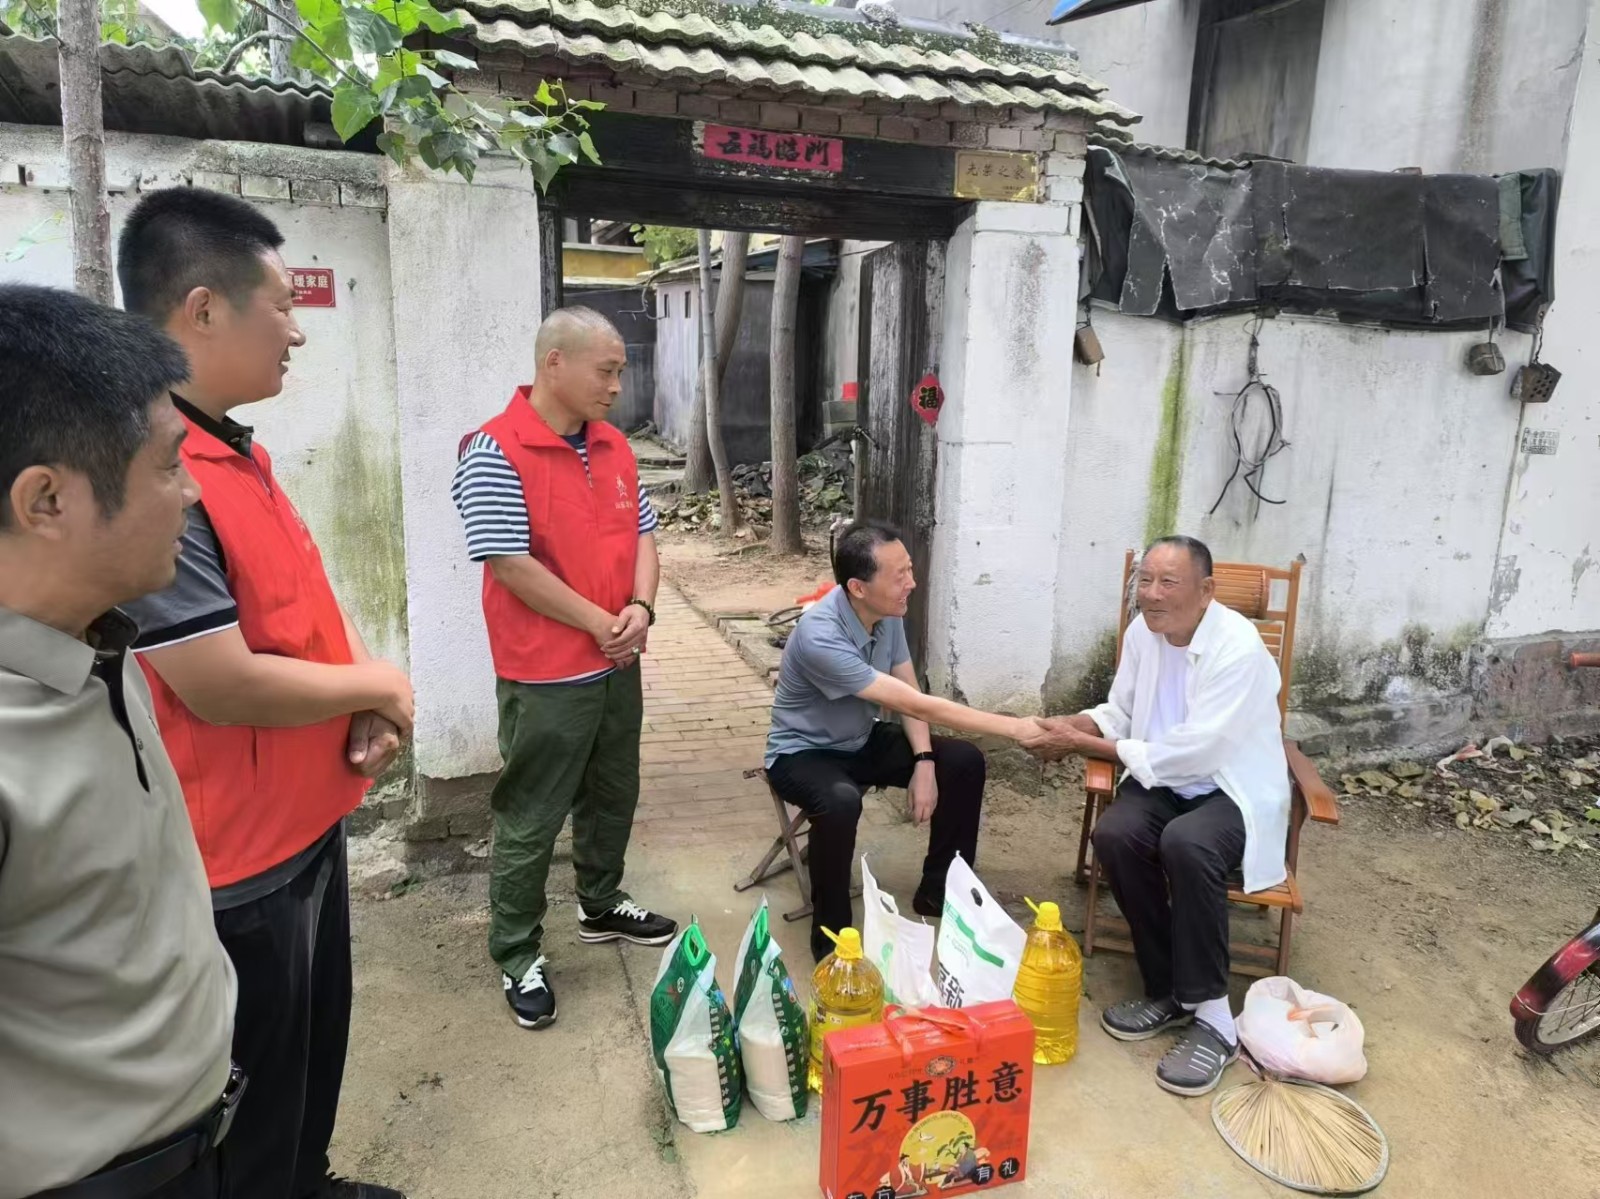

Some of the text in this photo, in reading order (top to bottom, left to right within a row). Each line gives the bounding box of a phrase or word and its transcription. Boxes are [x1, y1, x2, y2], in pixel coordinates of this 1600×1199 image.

[919, 386, 938, 409] 福
[852, 1062, 1023, 1133] 万事胜意
